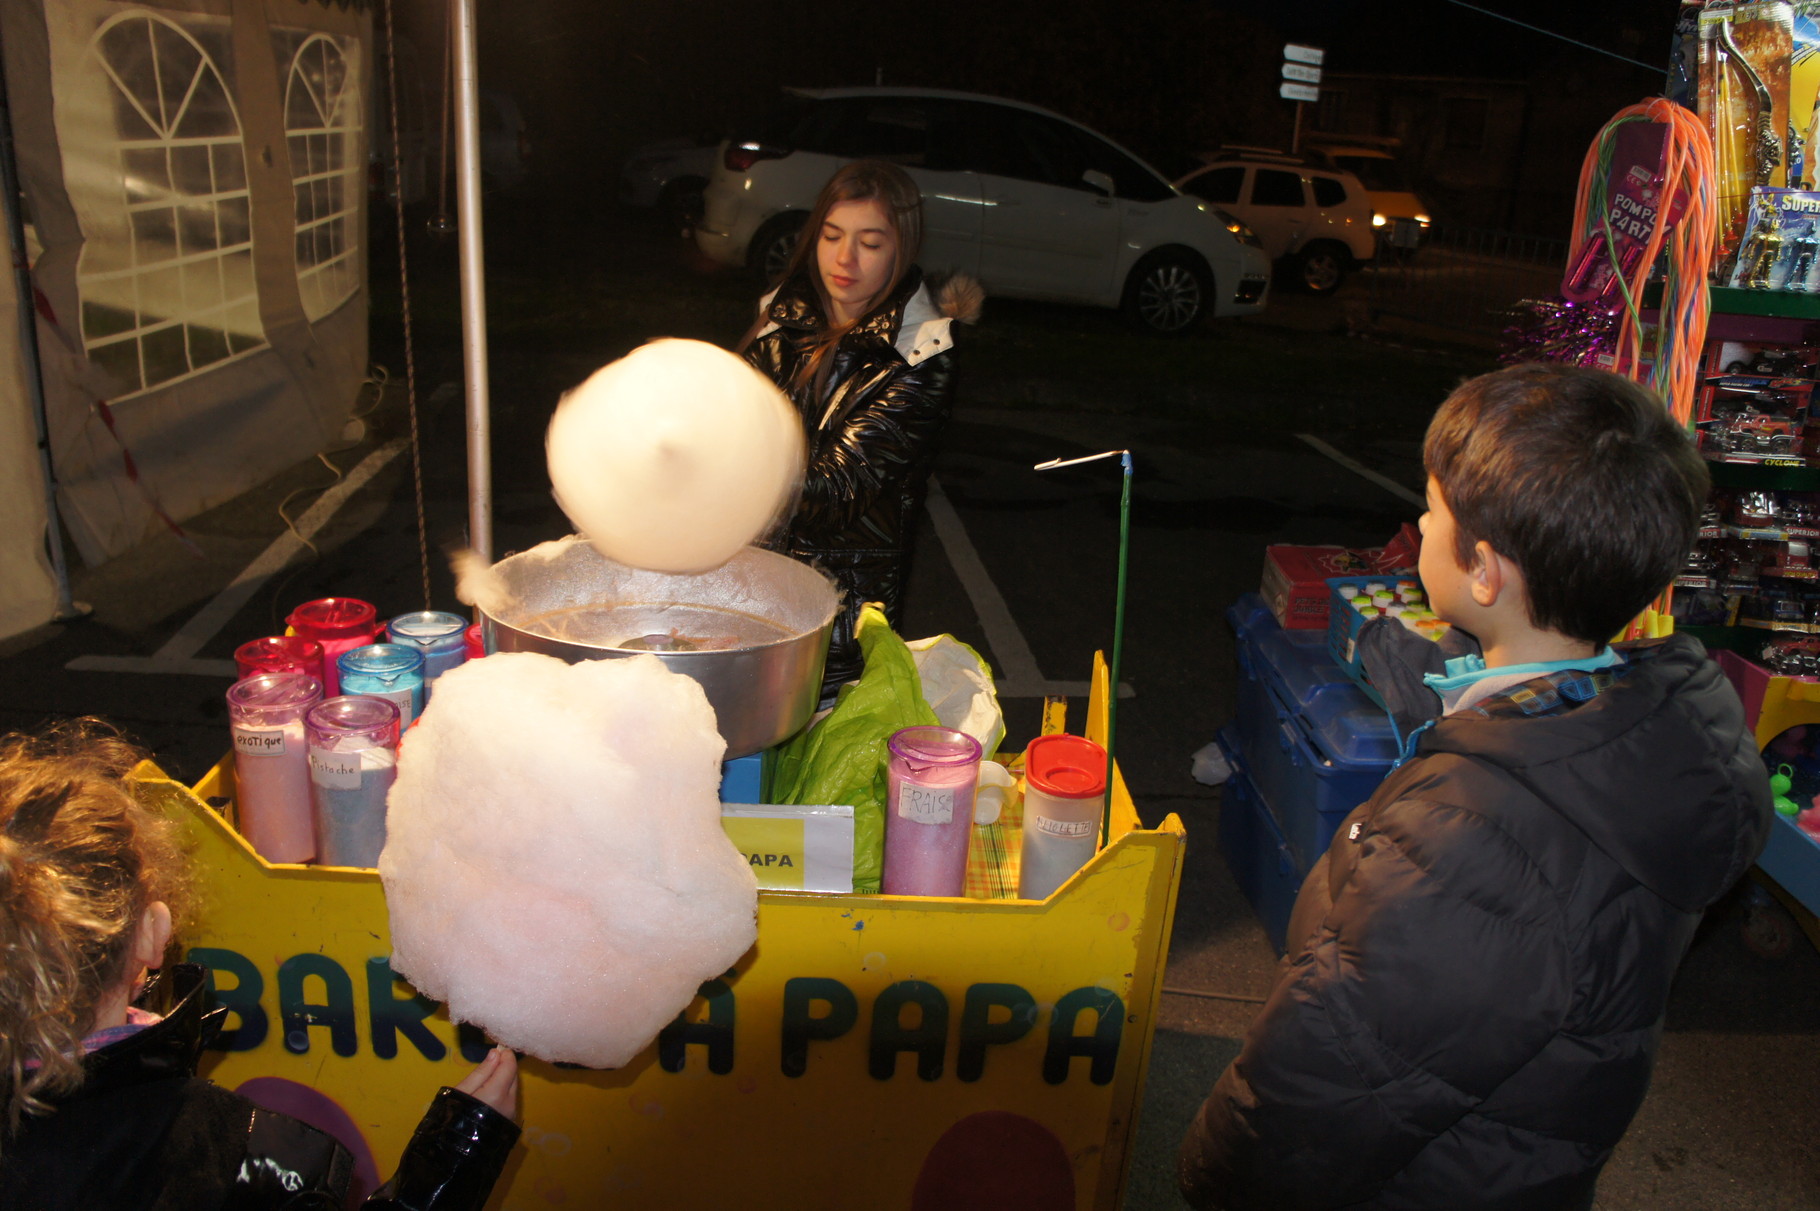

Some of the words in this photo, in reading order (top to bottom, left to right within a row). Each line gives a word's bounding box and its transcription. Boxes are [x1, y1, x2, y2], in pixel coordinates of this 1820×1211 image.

[1764, 458, 1800, 467] CYCLONE
[1787, 527, 1819, 537] SUPERIOR
[311, 755, 355, 775] Pistache
[187, 947, 540, 1067] BAR
[781, 977, 1126, 1086] PAPA
